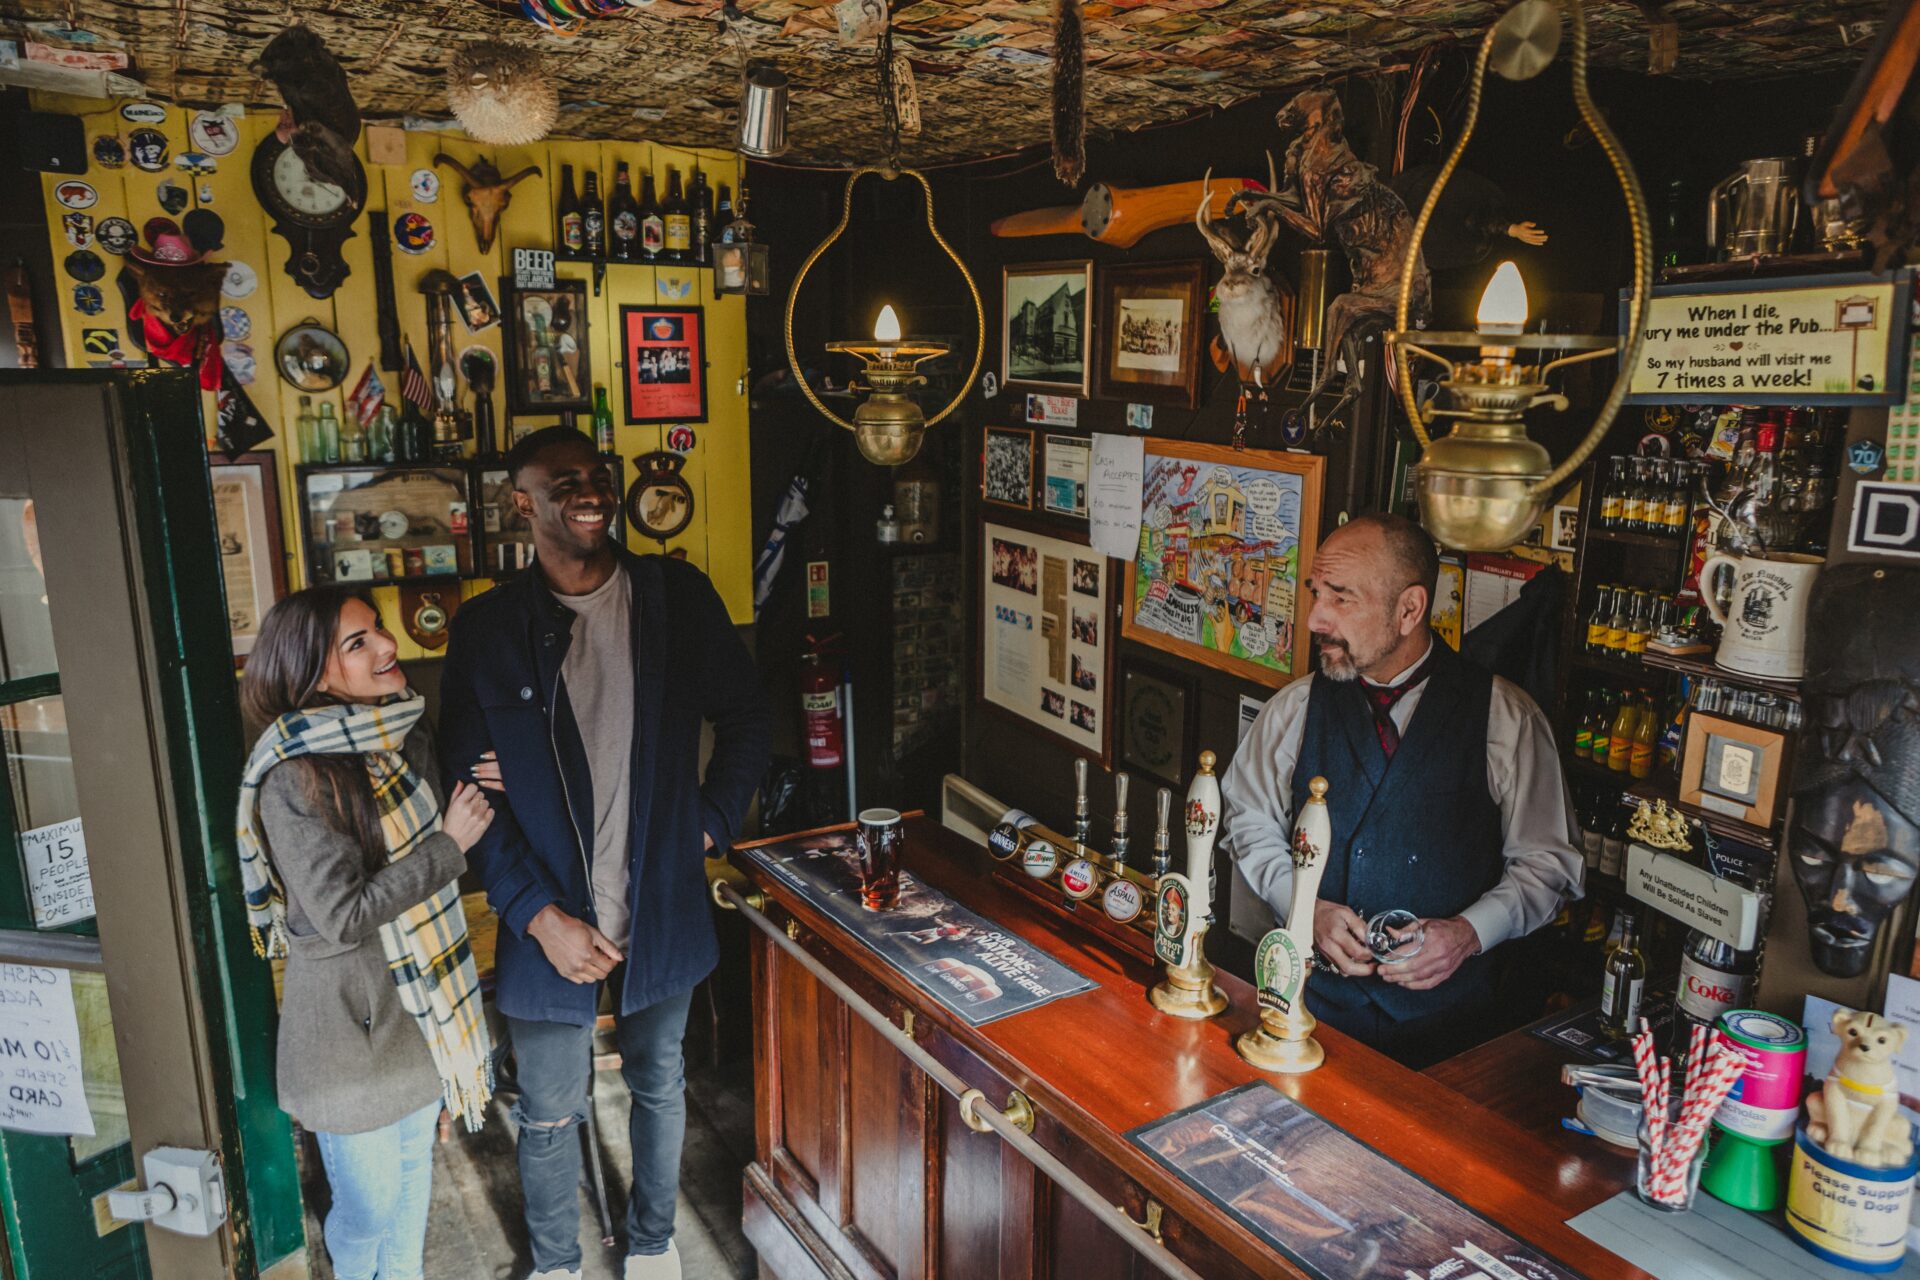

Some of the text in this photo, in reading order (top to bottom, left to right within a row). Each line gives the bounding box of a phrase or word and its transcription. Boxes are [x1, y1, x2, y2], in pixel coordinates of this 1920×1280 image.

[515, 248, 554, 272] BEER
[1688, 304, 1780, 322] When I die,
[1644, 318, 1832, 342] ury me under the Pub...
[1647, 353, 1832, 369] So my husband will visit me
[1657, 369, 1812, 389] 7 times a week!
[1051, 405, 1068, 416] TEXAS
[1095, 454, 1115, 467] CASH
[1854, 450, 1876, 464] 70
[1103, 470, 1140, 481] ACCEPTED
[1864, 493, 1920, 545] D
[1483, 564, 1512, 576] FEBRUARY
[1742, 569, 1793, 591] The Nutshell
[1166, 593, 1199, 615] SMALLEST
[46, 838, 73, 863] 15
[1023, 852, 1055, 863] San Miguel
[1715, 853, 1743, 867] POLICE
[40, 856, 88, 879] PEOPLE
[1069, 868, 1089, 882] AMSTEL
[42, 884, 85, 907] INSIDE
[1109, 886, 1135, 905] ASPALL
[1639, 868, 1729, 917] Any Unattended Children
[45, 903, 71, 920] ONE
[1642, 881, 1723, 927] Will Be Sold As Slaves
[989, 932, 1016, 949] OUR
[1157, 933, 1183, 954] ABBOT
[1162, 945, 1175, 959] ALE
[1257, 931, 1300, 983] GREENE KING
[975, 951, 1052, 998] ALIVE HERE
[1688, 975, 1735, 1003] Coke
[1720, 1099, 1768, 1122] icholas
[1802, 1160, 1911, 1199] Please Support
[1812, 1181, 1900, 1212] Guide Dogs
[1473, 1251, 1517, 1279] THE BURY
